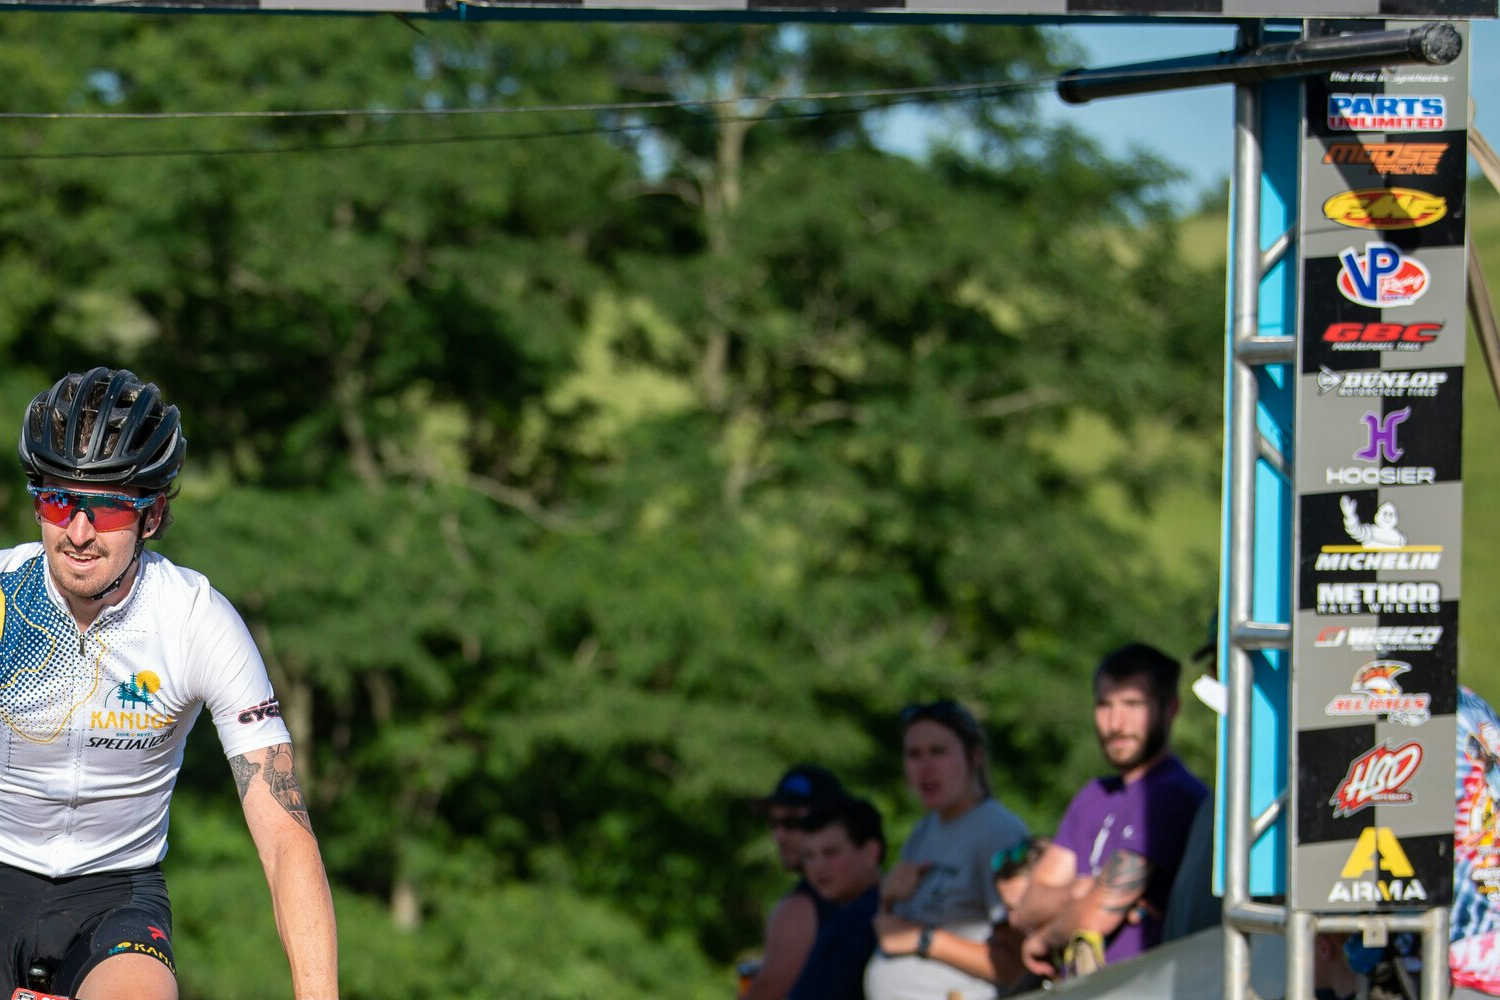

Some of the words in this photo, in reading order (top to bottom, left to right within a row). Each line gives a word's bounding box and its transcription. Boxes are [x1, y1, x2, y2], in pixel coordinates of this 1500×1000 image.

[1329, 97, 1443, 115] PARTS
[1330, 116, 1443, 129] UNLIMITED
[1322, 143, 1449, 165] MOOSE
[1342, 246, 1401, 302] VP
[1322, 322, 1444, 342] GBC
[1343, 372, 1448, 388] DUNLOP
[1407, 387, 1438, 397] TIRES
[1326, 466, 1436, 485] HOOSIER
[1315, 553, 1442, 571] MICHELIN
[1317, 582, 1440, 604] METHOD
[1317, 603, 1361, 614] RACE
[1368, 603, 1440, 614] WHEELS
[1327, 879, 1428, 902] ARMA
